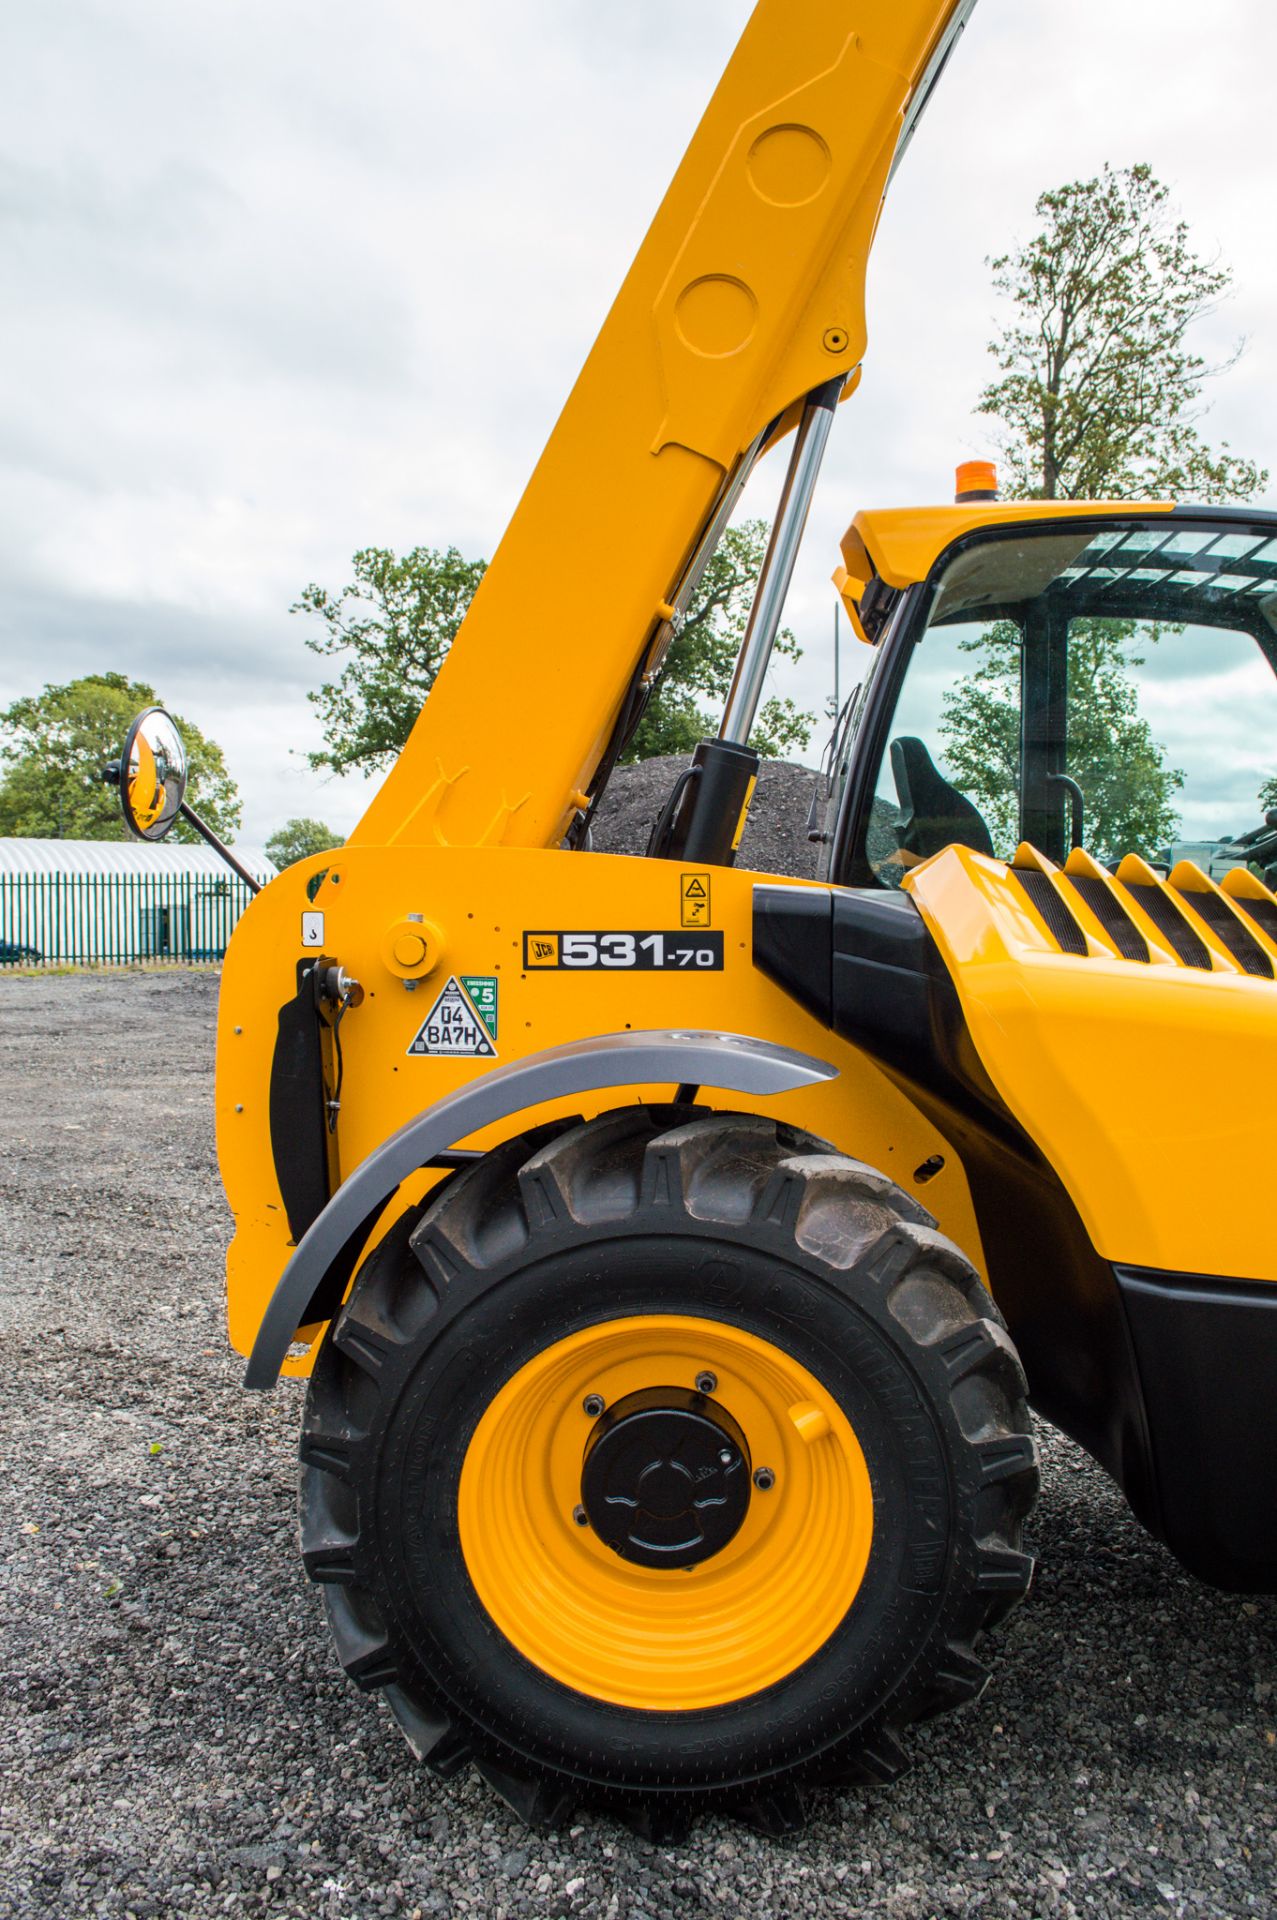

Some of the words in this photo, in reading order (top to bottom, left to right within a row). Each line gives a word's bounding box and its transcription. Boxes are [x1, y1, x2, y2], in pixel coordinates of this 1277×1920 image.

[535, 943, 553, 958] JCB
[562, 934, 715, 967] 531-70
[481, 987, 494, 1003] 5
[428, 1026, 477, 1046] BA7H
